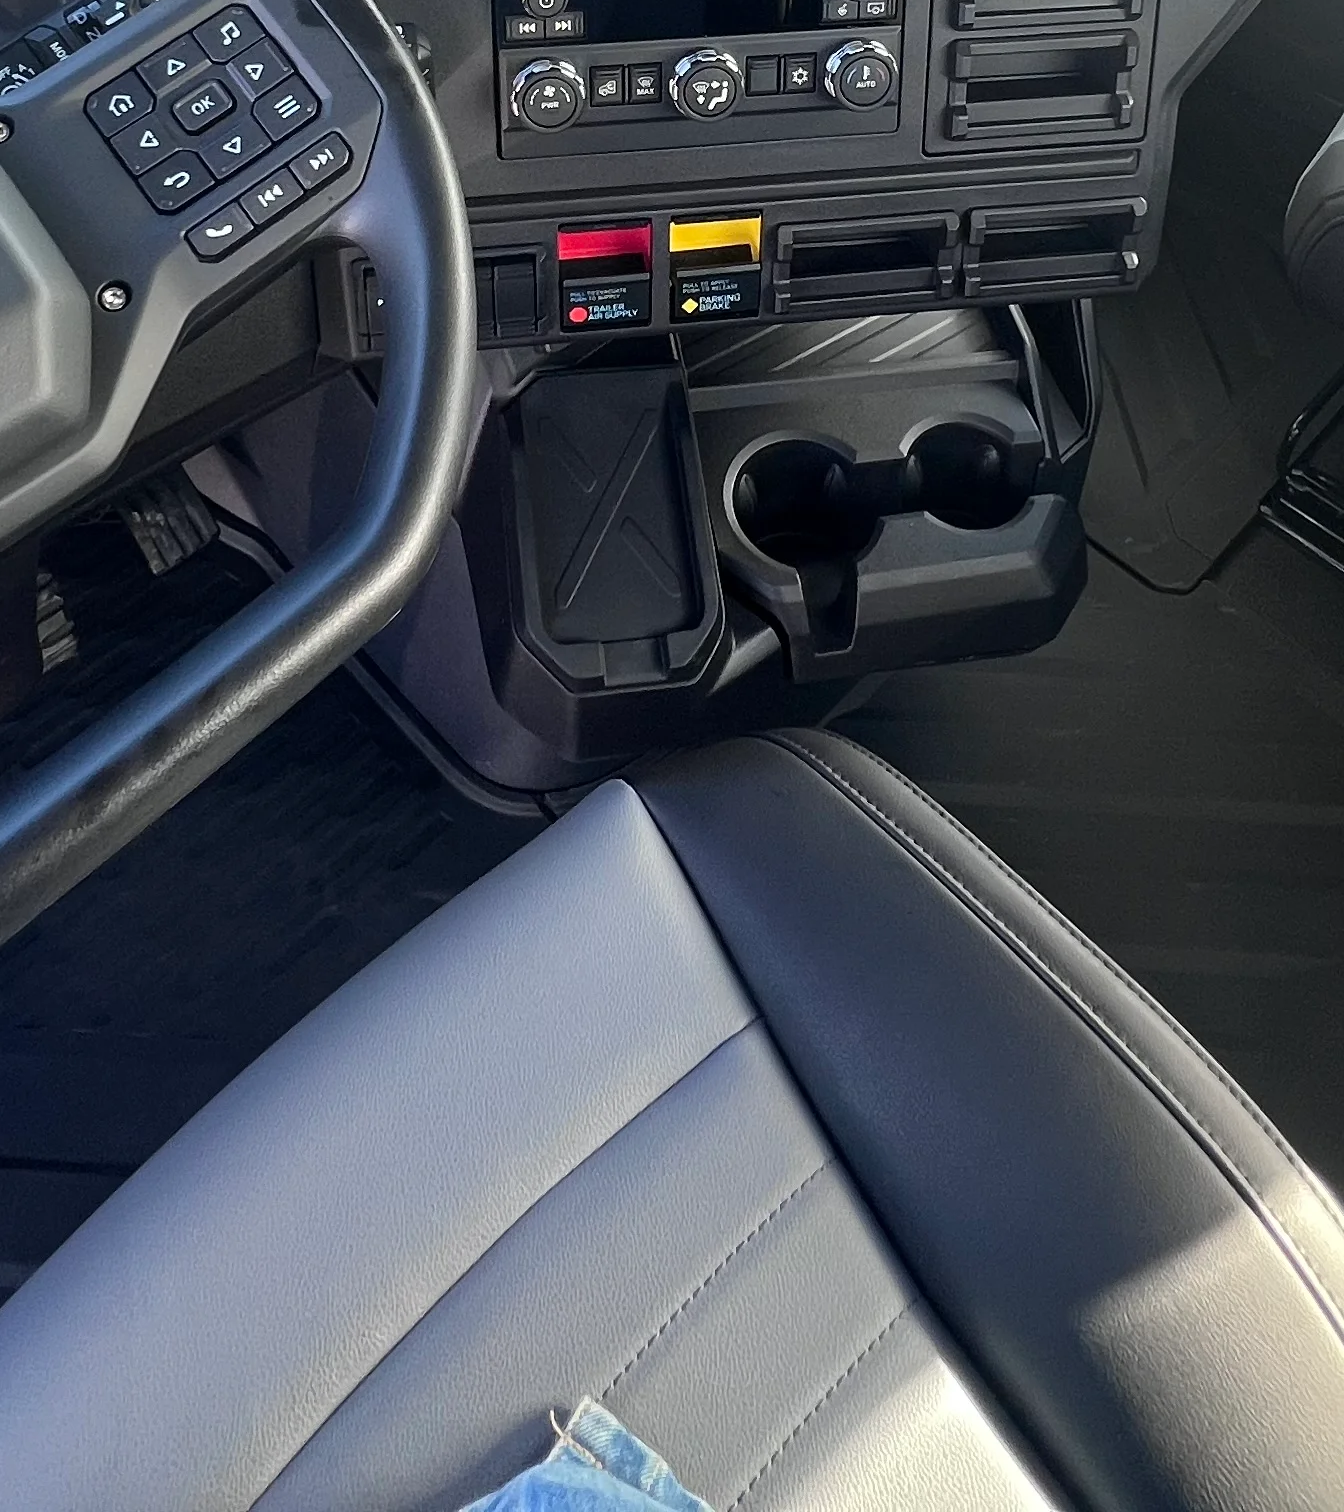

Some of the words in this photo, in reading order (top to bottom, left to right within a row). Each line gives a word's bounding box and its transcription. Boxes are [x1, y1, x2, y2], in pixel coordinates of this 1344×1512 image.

[856, 80, 876, 89] AUTO
[636, 86, 655, 96] MAX
[191, 94, 216, 118] OK
[541, 100, 560, 110] PWR
